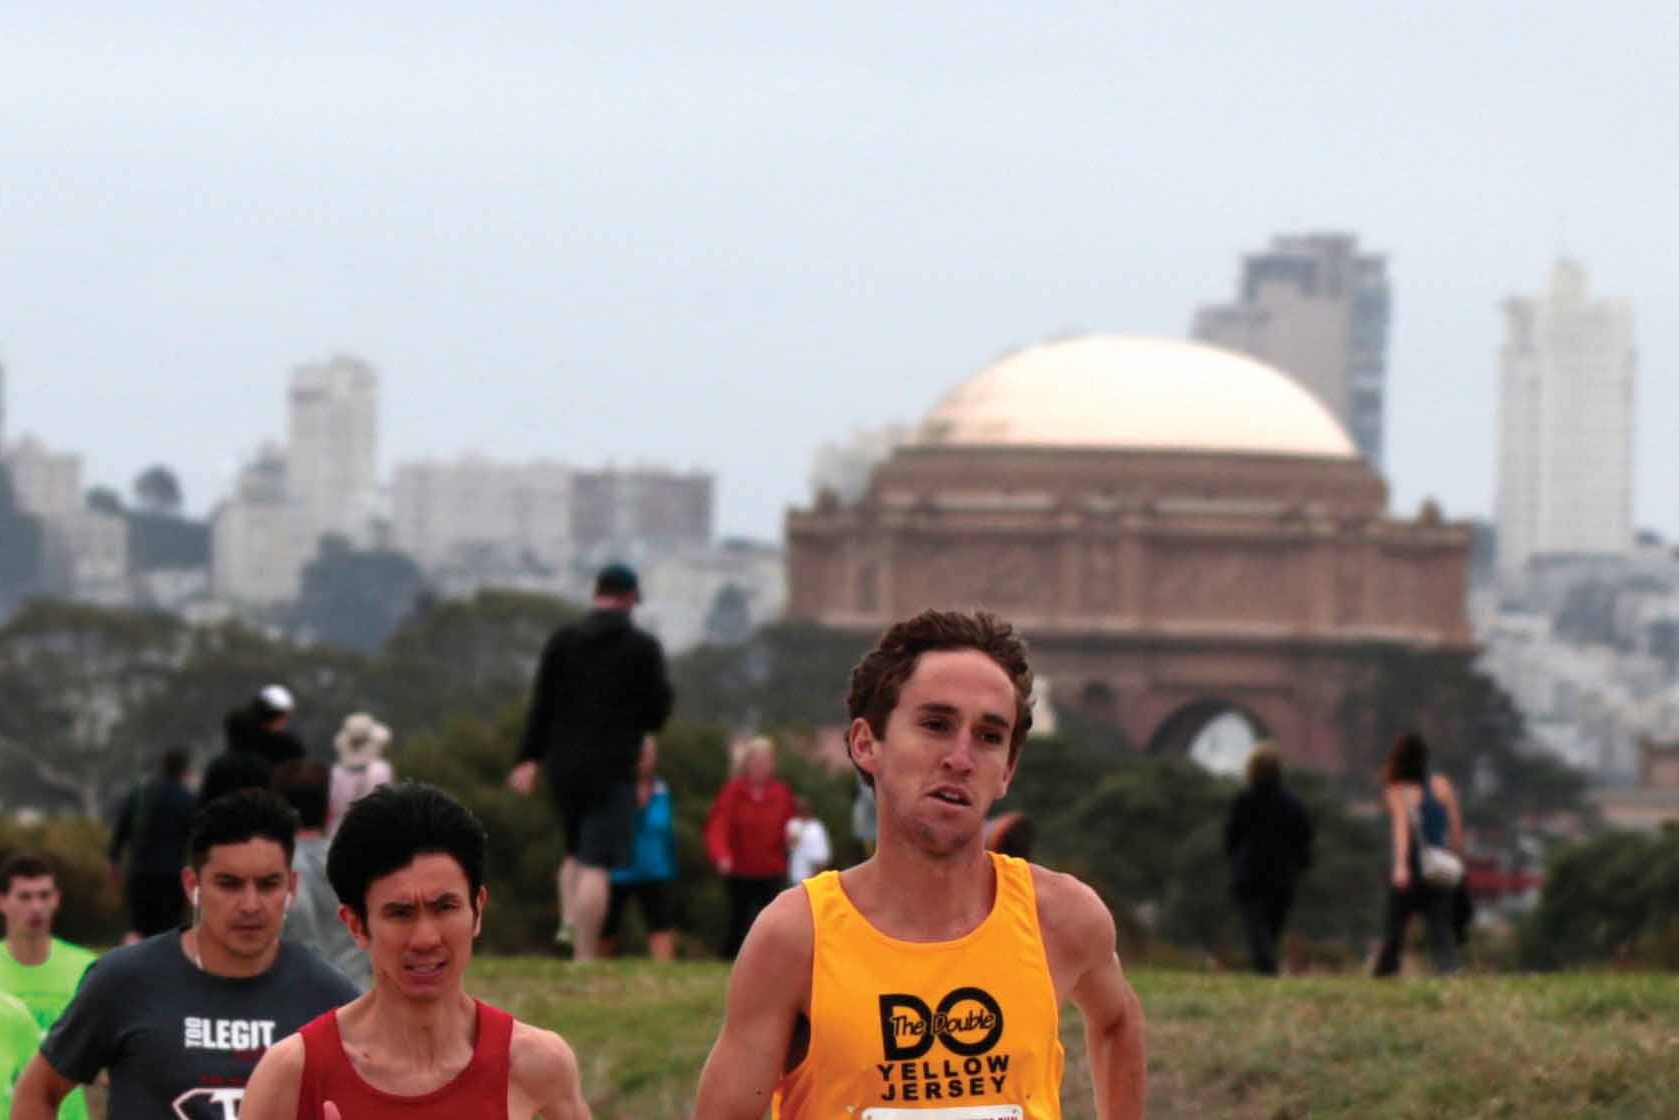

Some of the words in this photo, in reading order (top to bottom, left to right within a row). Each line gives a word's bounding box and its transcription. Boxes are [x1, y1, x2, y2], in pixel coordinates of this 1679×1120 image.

[185, 1016, 203, 1048] TOO
[202, 1018, 276, 1050] LEGIT
[891, 1016, 924, 1036] The
[932, 1010, 995, 1036] Double
[877, 1055, 1009, 1081] YELLOW
[881, 1075, 1006, 1101] JERSEY
